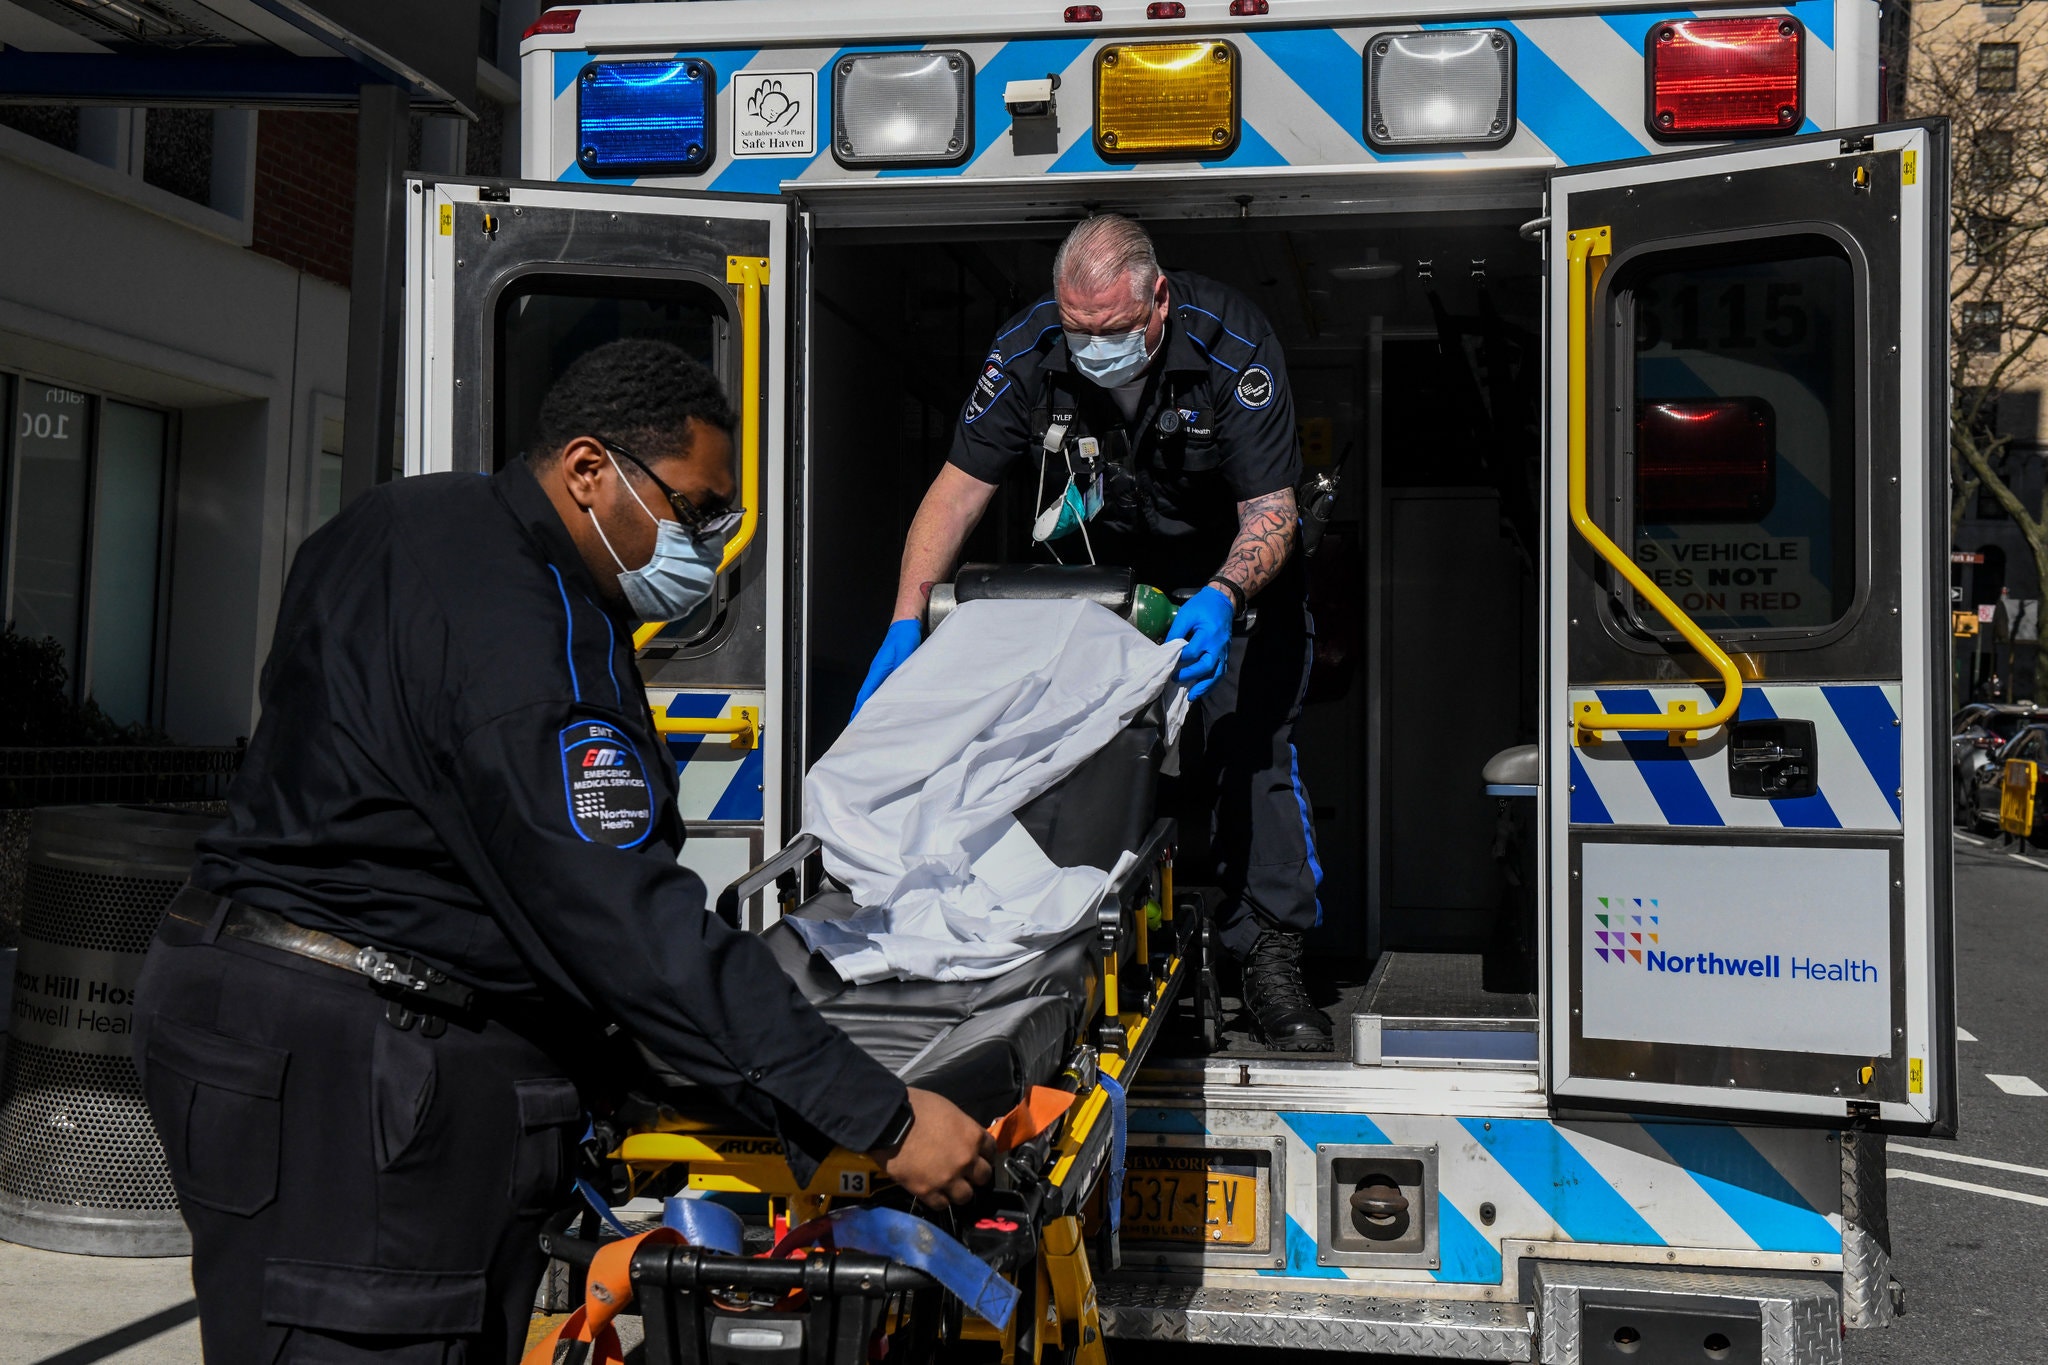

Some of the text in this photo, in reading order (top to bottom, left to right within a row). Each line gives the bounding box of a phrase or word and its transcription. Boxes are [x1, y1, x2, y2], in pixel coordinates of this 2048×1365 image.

[742, 138, 804, 149] Safe Haven
[1671, 542, 1798, 562] VEHICLE
[1708, 567, 1778, 587] NOT
[1682, 592, 1801, 611] ON RED
[588, 726, 614, 738] EMT
[582, 748, 627, 767] EMS
[583, 770, 631, 779] EMERGENCY
[573, 778, 646, 790] MEDICAL SERVICES
[600, 809, 650, 819] Northwell
[601, 820, 635, 830] Health
[1647, 949, 1878, 983] Northwell Health
[44, 974, 80, 1001] Hill
[87, 981, 135, 1006] Hos
[77, 1008, 133, 1035] Heal
[1124, 1155, 1214, 1170] NEW YORK
[842, 1174, 865, 1192] 13
